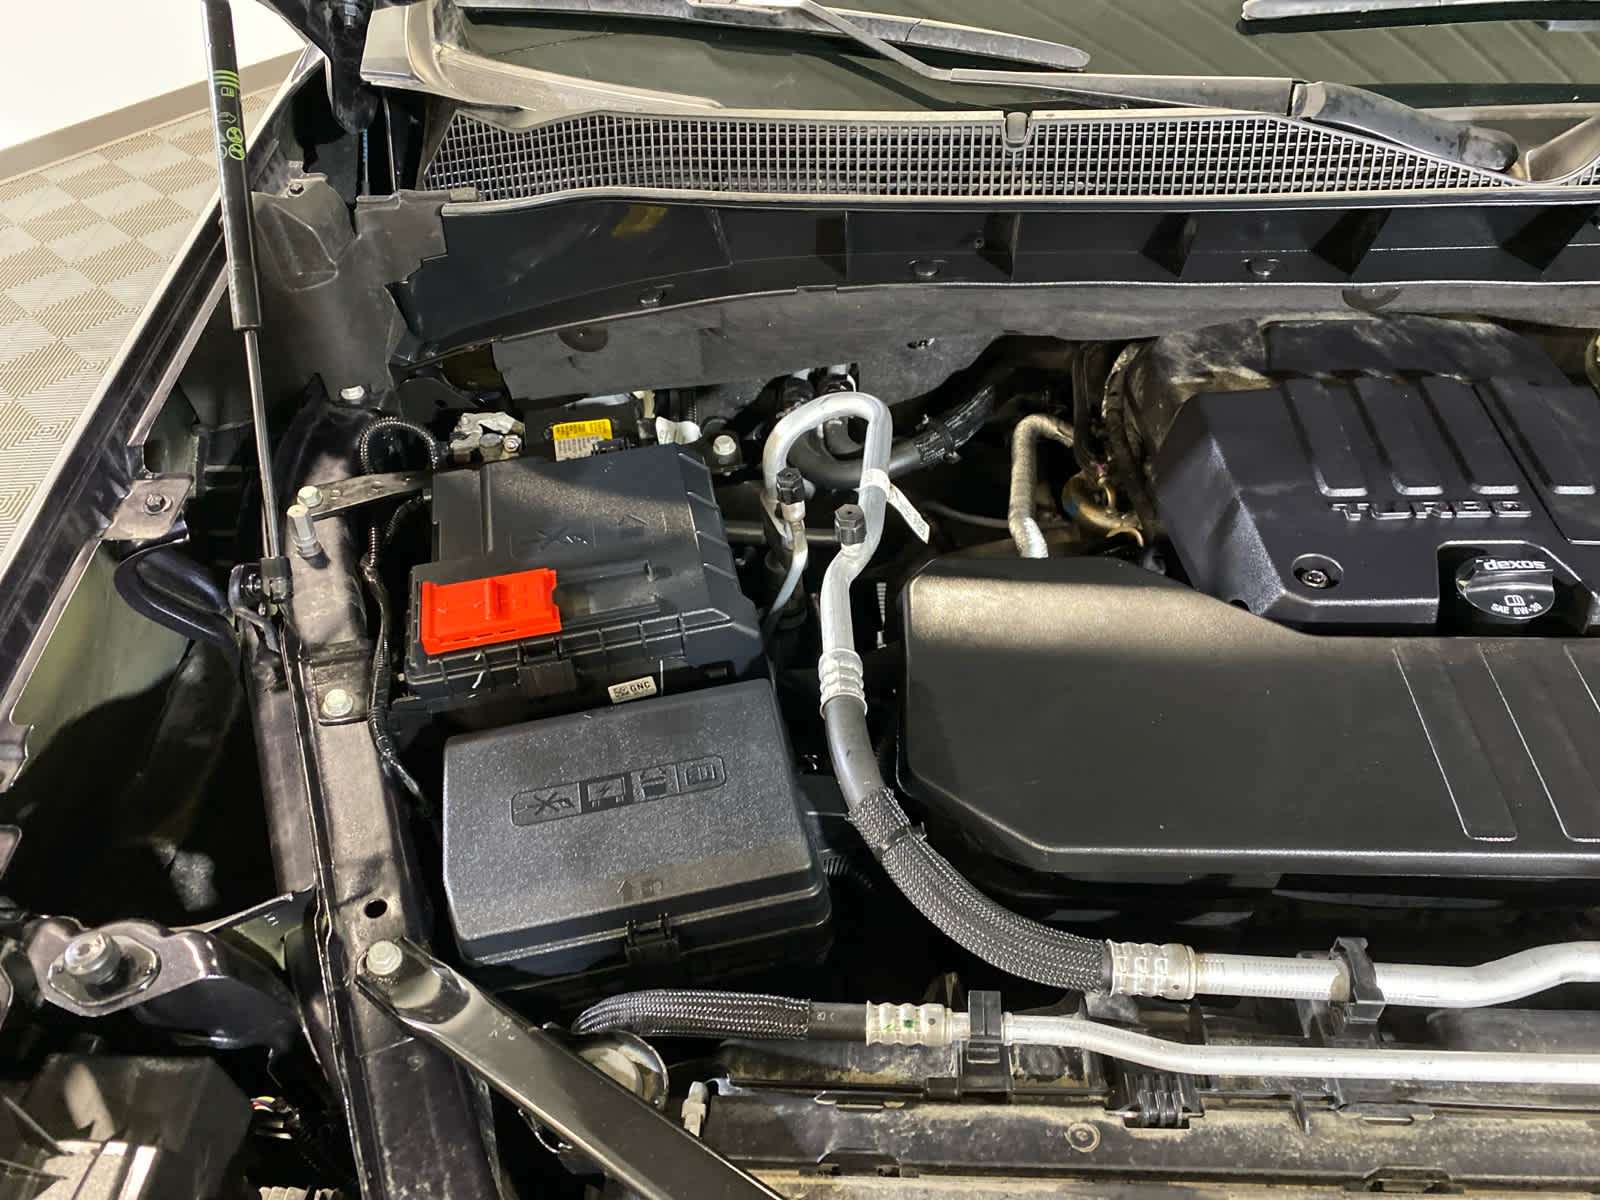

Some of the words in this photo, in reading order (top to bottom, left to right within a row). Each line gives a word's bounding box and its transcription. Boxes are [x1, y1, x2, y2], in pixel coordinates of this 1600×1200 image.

[1332, 501, 1532, 521] TURBO
[1484, 559, 1546, 571] dexos
[1491, 603, 1510, 615] SAE
